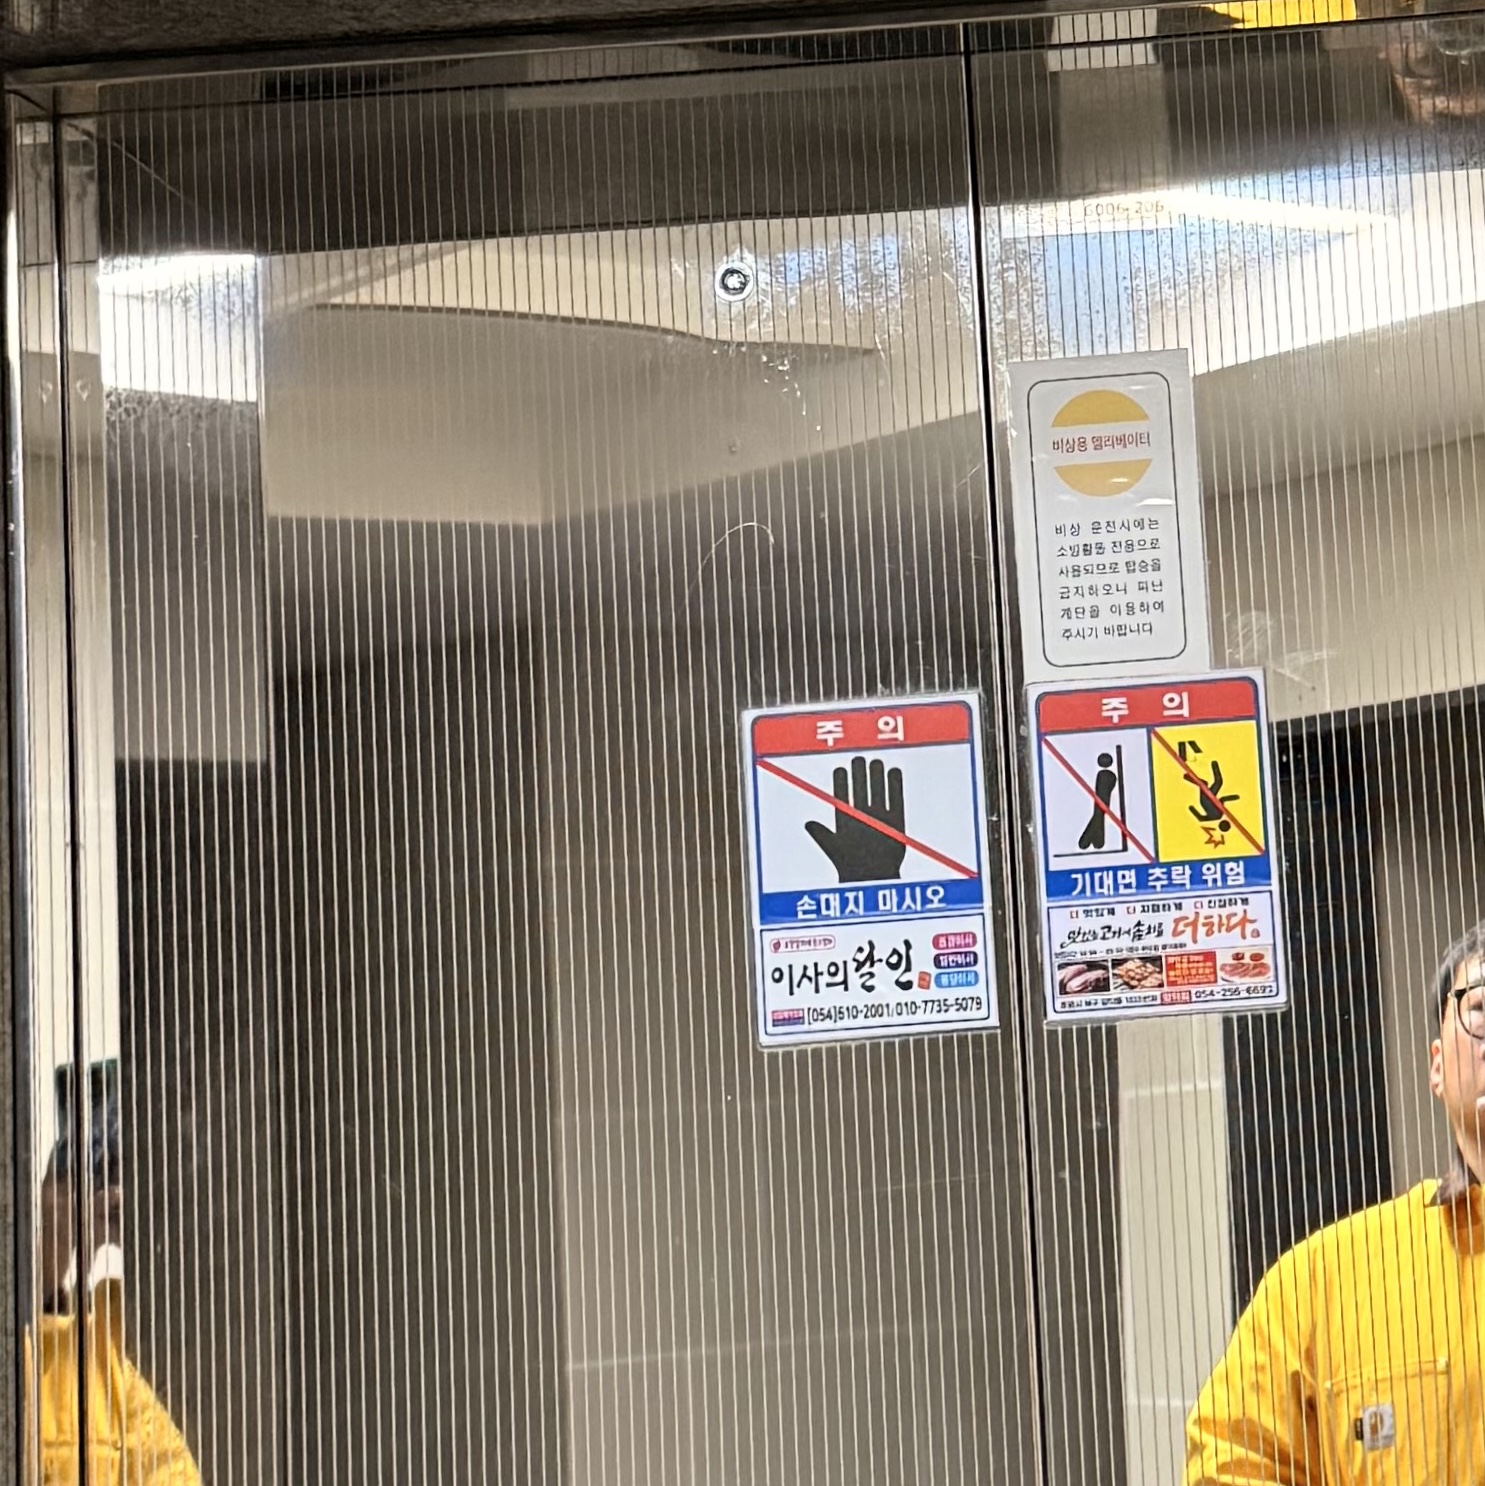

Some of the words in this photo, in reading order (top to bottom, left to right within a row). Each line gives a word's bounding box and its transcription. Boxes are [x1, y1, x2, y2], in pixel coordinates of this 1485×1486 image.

[1052, 436, 1088, 454] 비상용
[1091, 431, 1151, 451] 엘리베이터
[1055, 522, 1081, 537] 비상
[1091, 517, 1159, 535] 운전시에는
[1111, 538, 1161, 554] 전용으로
[1059, 562, 1120, 578] 사용되므로
[1125, 558, 1161, 574] 탑승을
[1059, 582, 1127, 600] 금지하오니
[1138, 579, 1163, 593] 피난
[1060, 604, 1100, 620] 계단을
[1110, 600, 1164, 616] 이용하여
[1062, 626, 1098, 641] 주시기
[1103, 621, 1153, 637] 바랍니다
[1071, 868, 1137, 897] 기대면
[1147, 864, 1192, 892] 추락
[1201, 861, 1245, 887] 위험
[796, 891, 865, 920] 손대지
[877, 885, 947, 912] 마시오
[1171, 909, 1258, 944] 더하다
